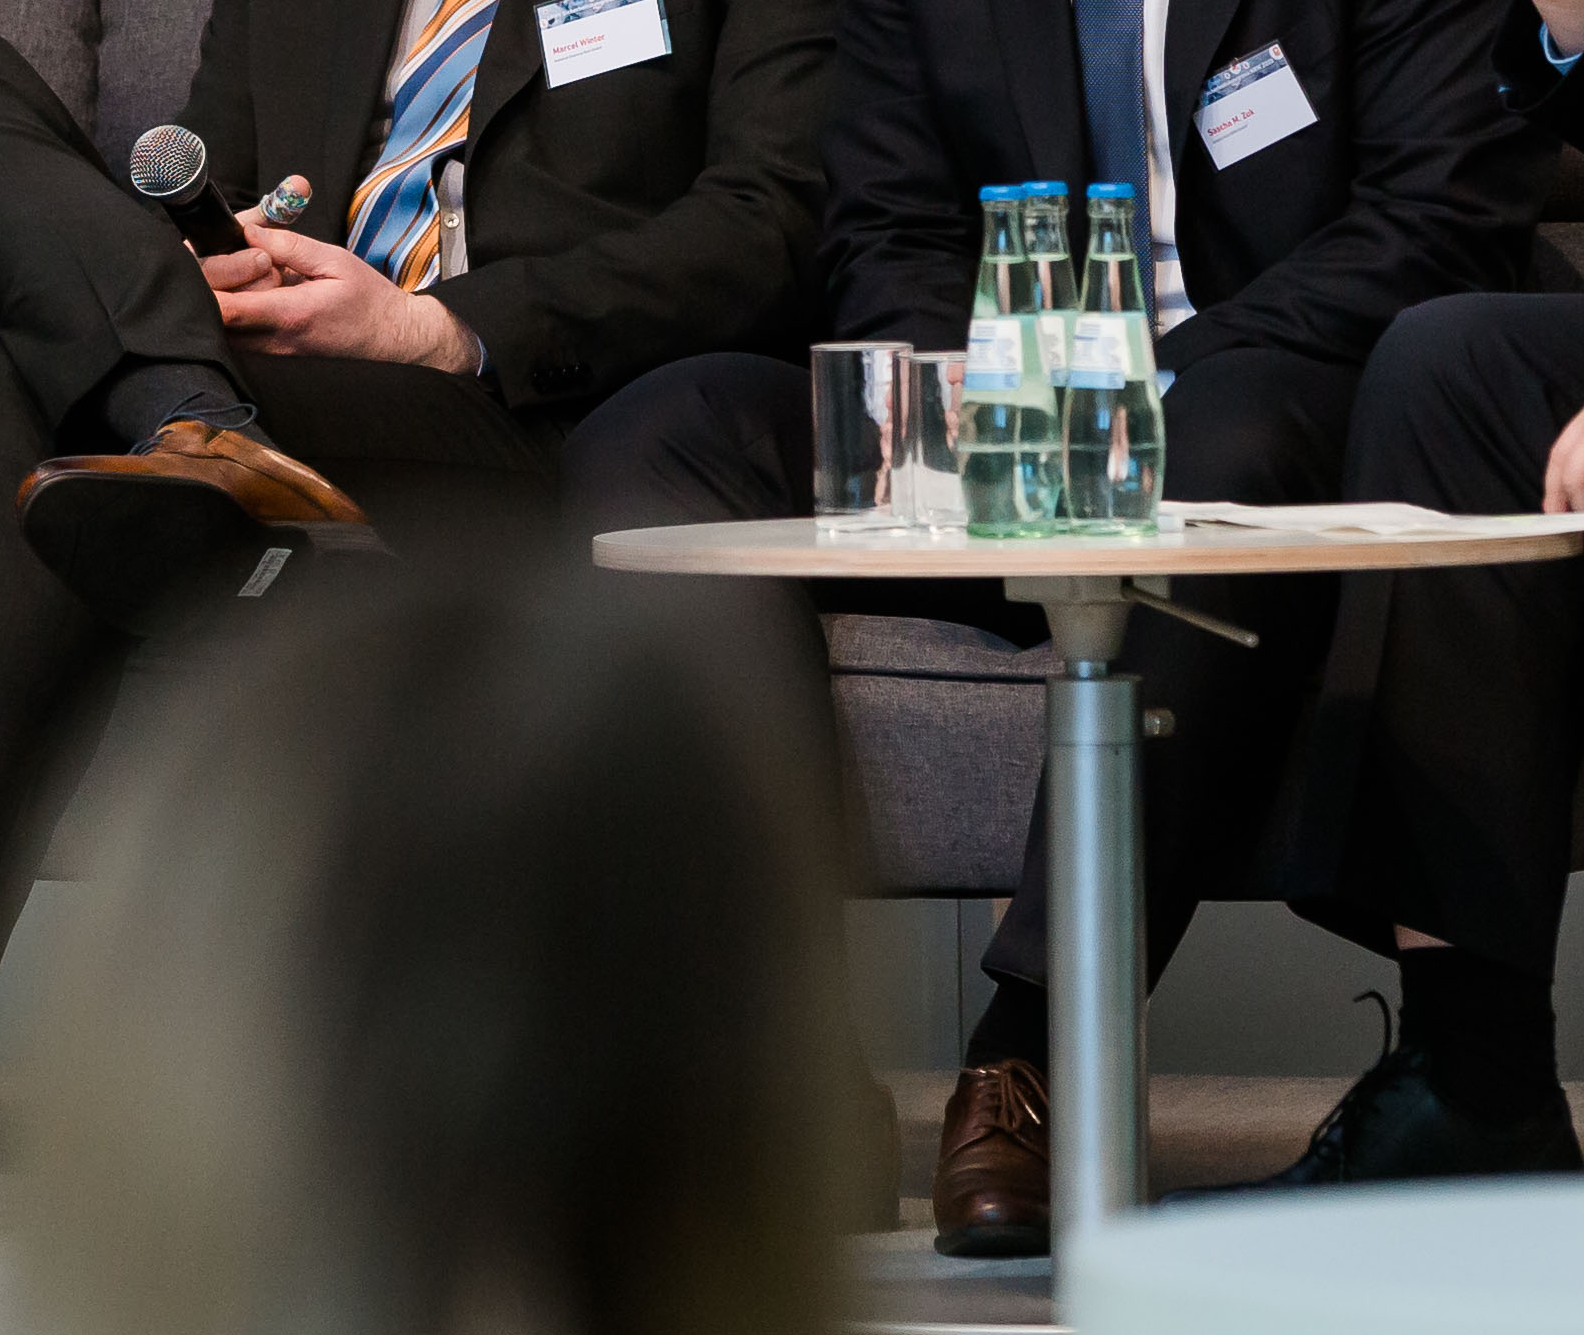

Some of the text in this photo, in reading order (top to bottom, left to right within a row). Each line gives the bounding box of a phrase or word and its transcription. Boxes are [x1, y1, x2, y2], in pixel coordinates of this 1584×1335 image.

[552, 41, 579, 55] Marcel
[579, 34, 605, 47] Winter
[1207, 120, 1233, 137] Sascha
